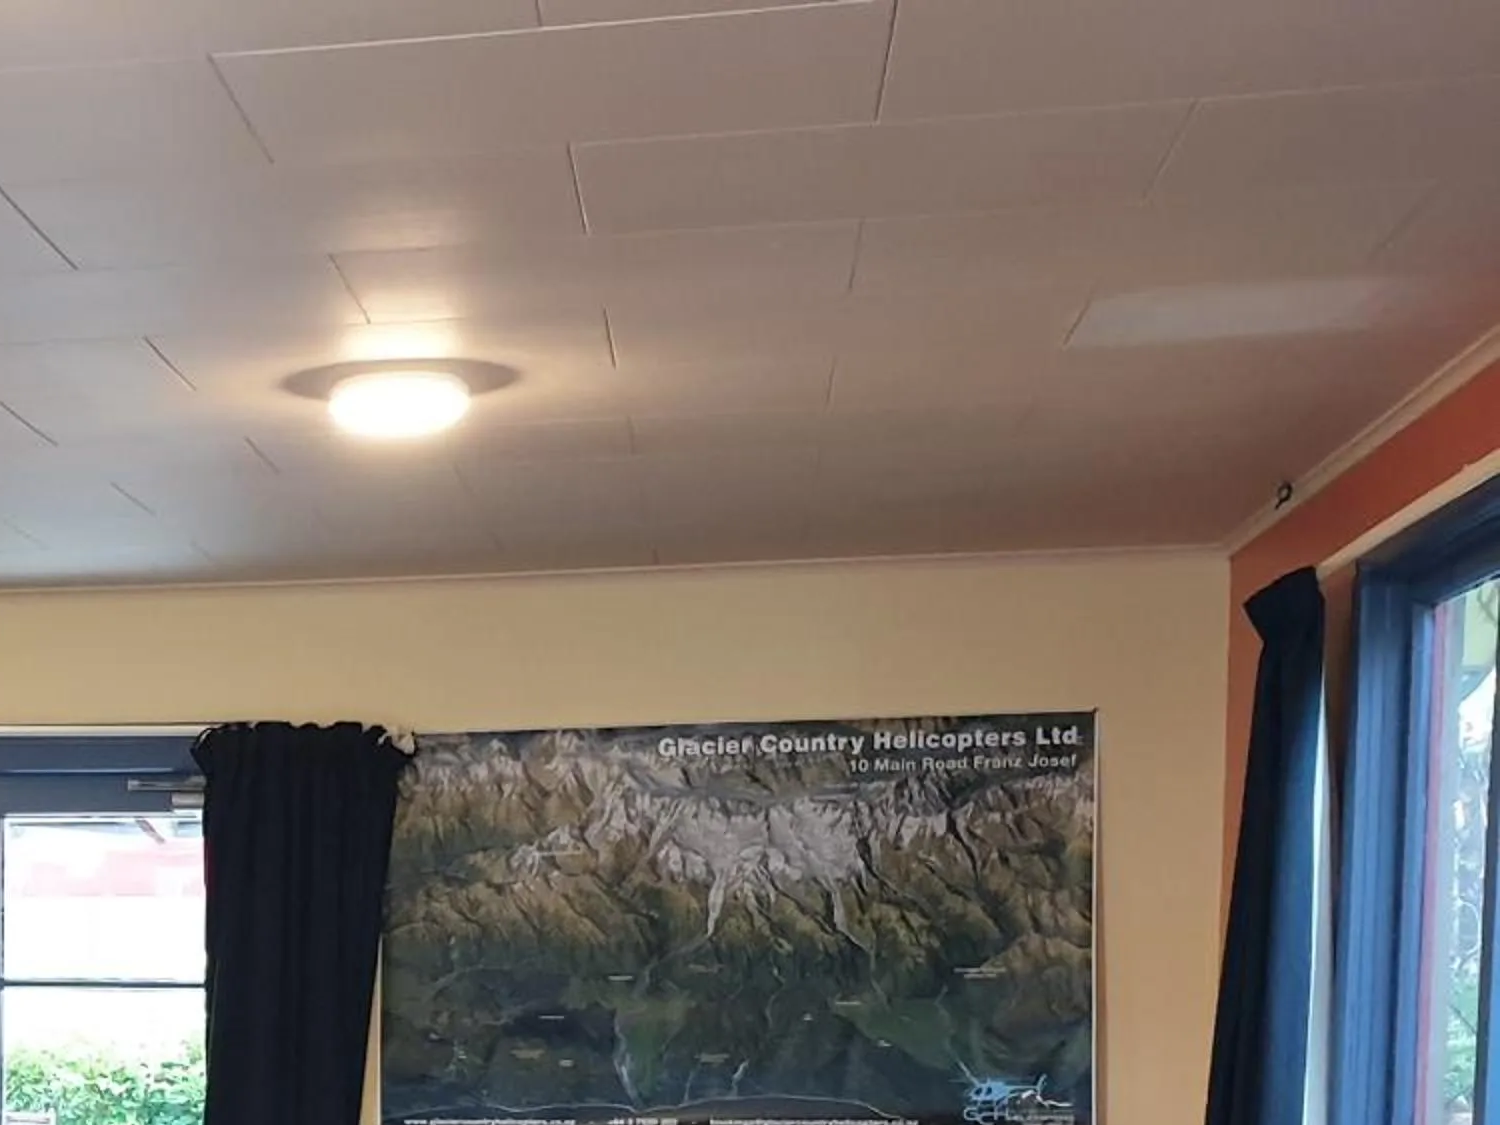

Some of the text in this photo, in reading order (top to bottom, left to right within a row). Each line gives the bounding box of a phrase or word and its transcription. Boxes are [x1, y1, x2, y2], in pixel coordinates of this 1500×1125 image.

[658, 725, 1079, 757] Glacier Country Helicopters Ltd
[849, 753, 1078, 773] 10 Main Road Franz Josef
